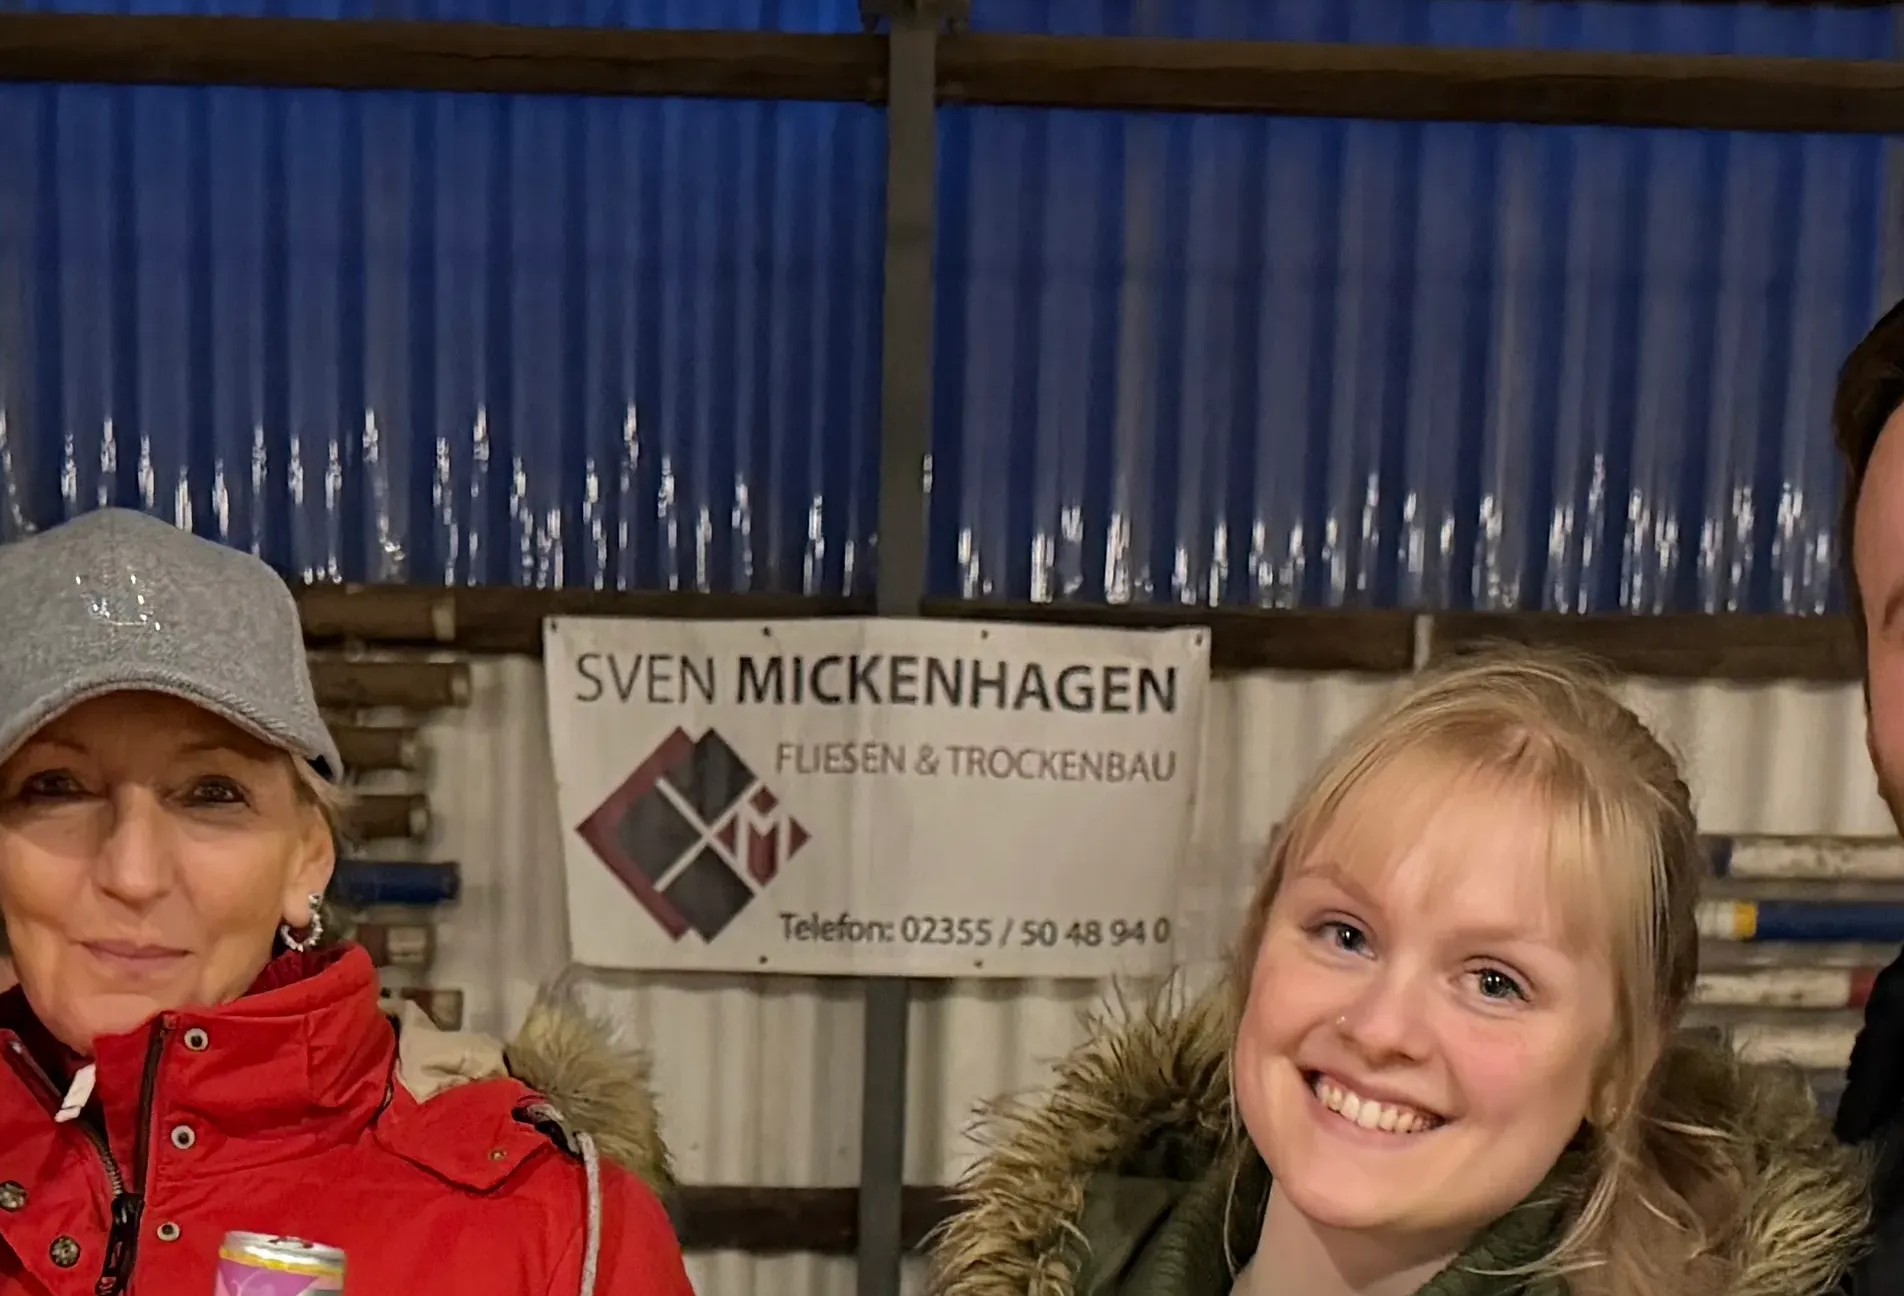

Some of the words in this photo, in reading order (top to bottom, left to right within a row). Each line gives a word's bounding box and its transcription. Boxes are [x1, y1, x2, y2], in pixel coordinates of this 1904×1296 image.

[576, 653, 715, 704] SVEN
[735, 655, 1177, 715] MICKENHAGEN
[776, 742, 906, 775] FLIESEN
[914, 744, 940, 777] &
[945, 746, 1176, 782] TROCKENBAU
[780, 911, 895, 943] Telefon:
[900, 914, 993, 946] 02355
[998, 916, 1015, 949] /
[1019, 919, 1058, 947] 50
[1065, 920, 1104, 948] 48
